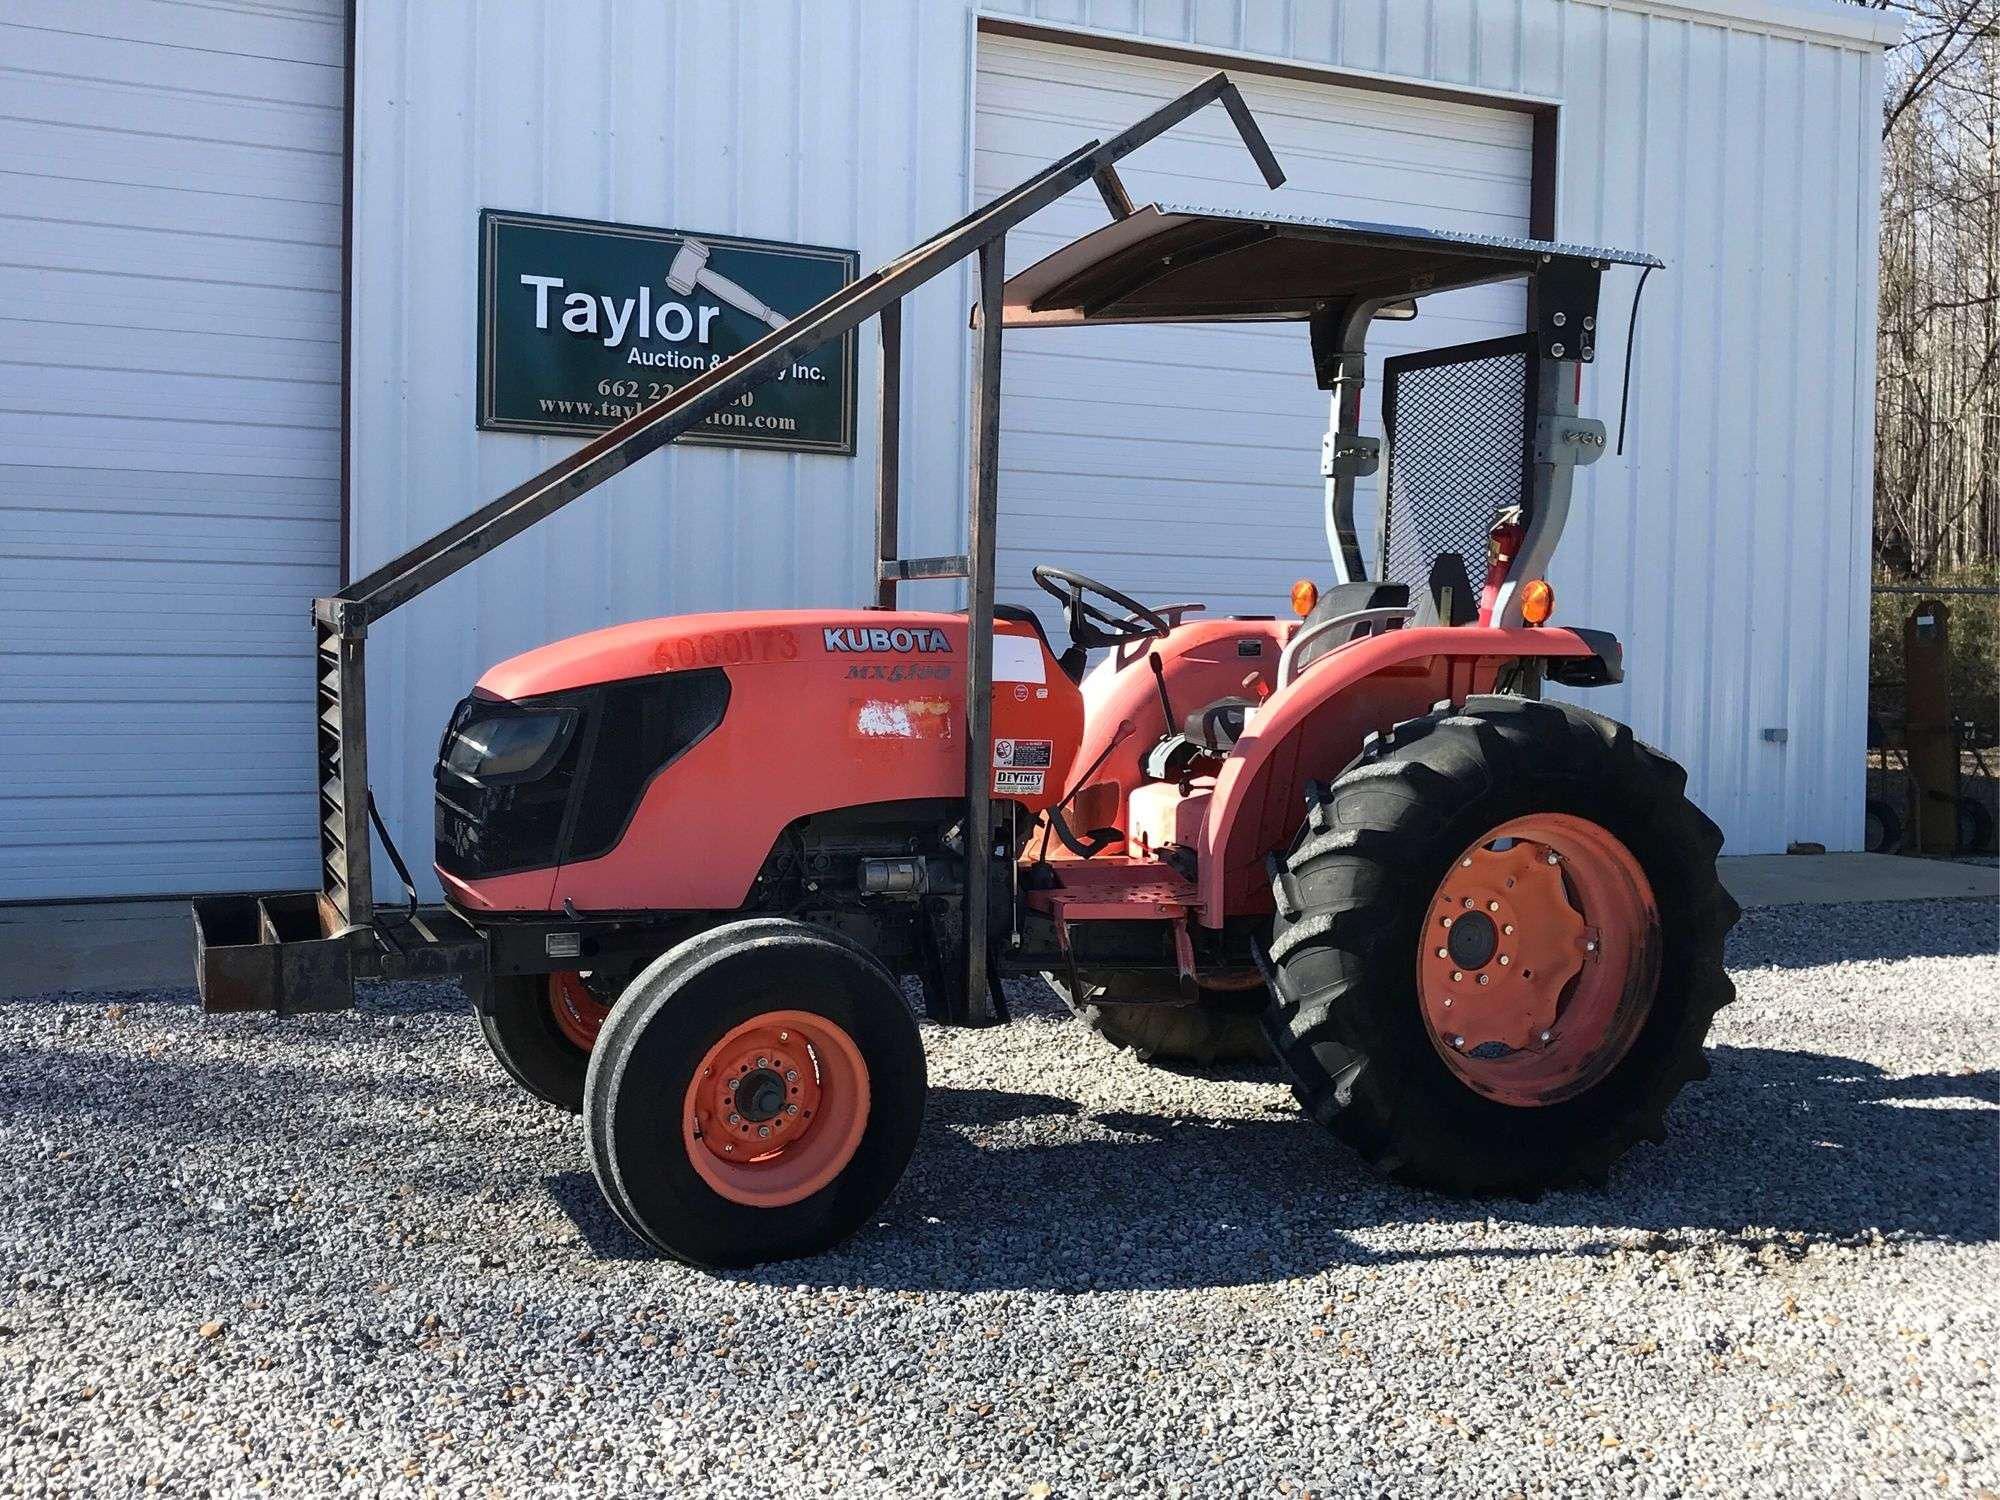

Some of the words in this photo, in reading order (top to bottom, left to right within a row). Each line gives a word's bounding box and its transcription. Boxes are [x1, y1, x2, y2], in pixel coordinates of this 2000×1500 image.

[520, 274, 720, 347] Taylor
[627, 347, 704, 370] Auction
[792, 363, 826, 380] Inc.
[597, 379, 639, 398] 662
[823, 626, 952, 652] KUBOTA
